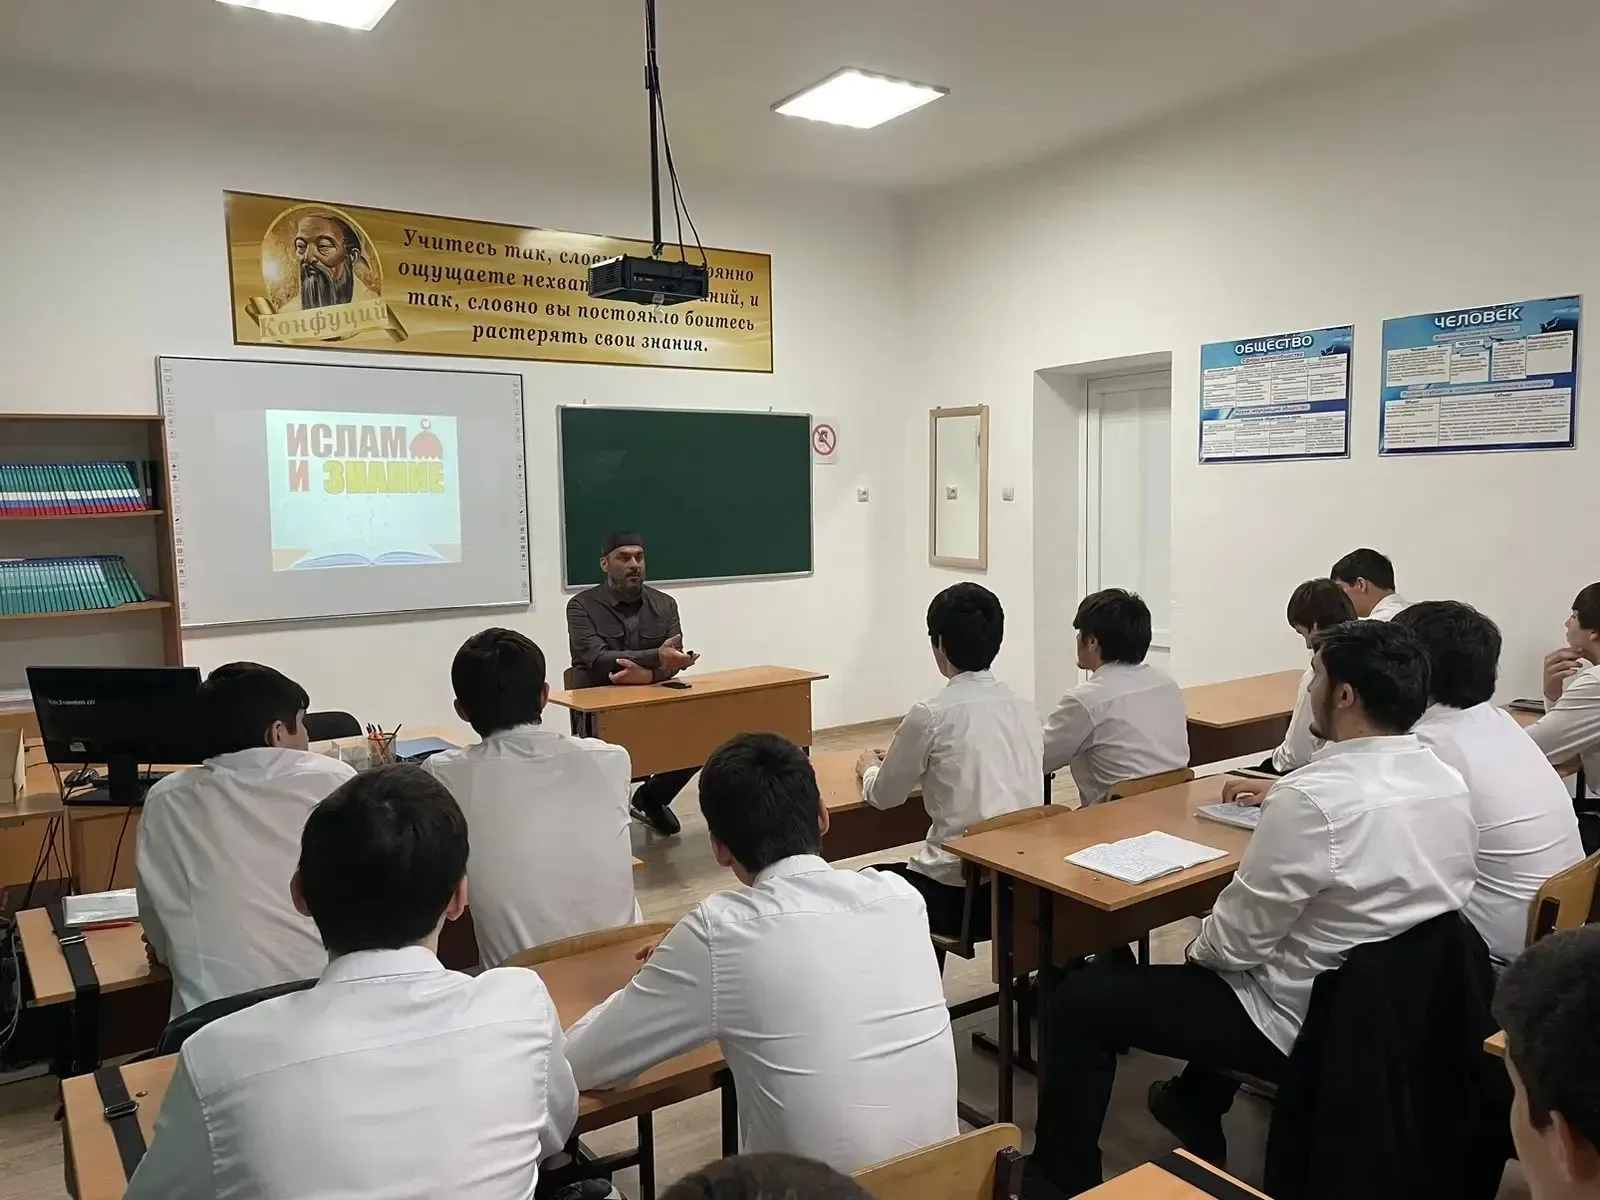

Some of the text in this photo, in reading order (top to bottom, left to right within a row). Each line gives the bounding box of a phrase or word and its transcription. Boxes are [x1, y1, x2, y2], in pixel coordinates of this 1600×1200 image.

[403, 229, 497, 256] Учитесь
[505, 245, 552, 265] так,
[560, 251, 613, 266] слов
[398, 262, 759, 309] ощущаете нехват ний, и
[260, 300, 388, 337] Конфуций
[407, 291, 460, 312] так,
[468, 296, 538, 315] словно
[545, 303, 571, 317] вы
[685, 310, 755, 330] боитесь
[1434, 307, 1520, 328] ЧЕЛОВЕК
[472, 324, 708, 352] растерять свои знания.
[1234, 335, 1312, 355] ОБЩЕСТВО
[286, 423, 407, 458] ИСЛАМ
[288, 459, 445, 494] И ЗНАНИЕ
